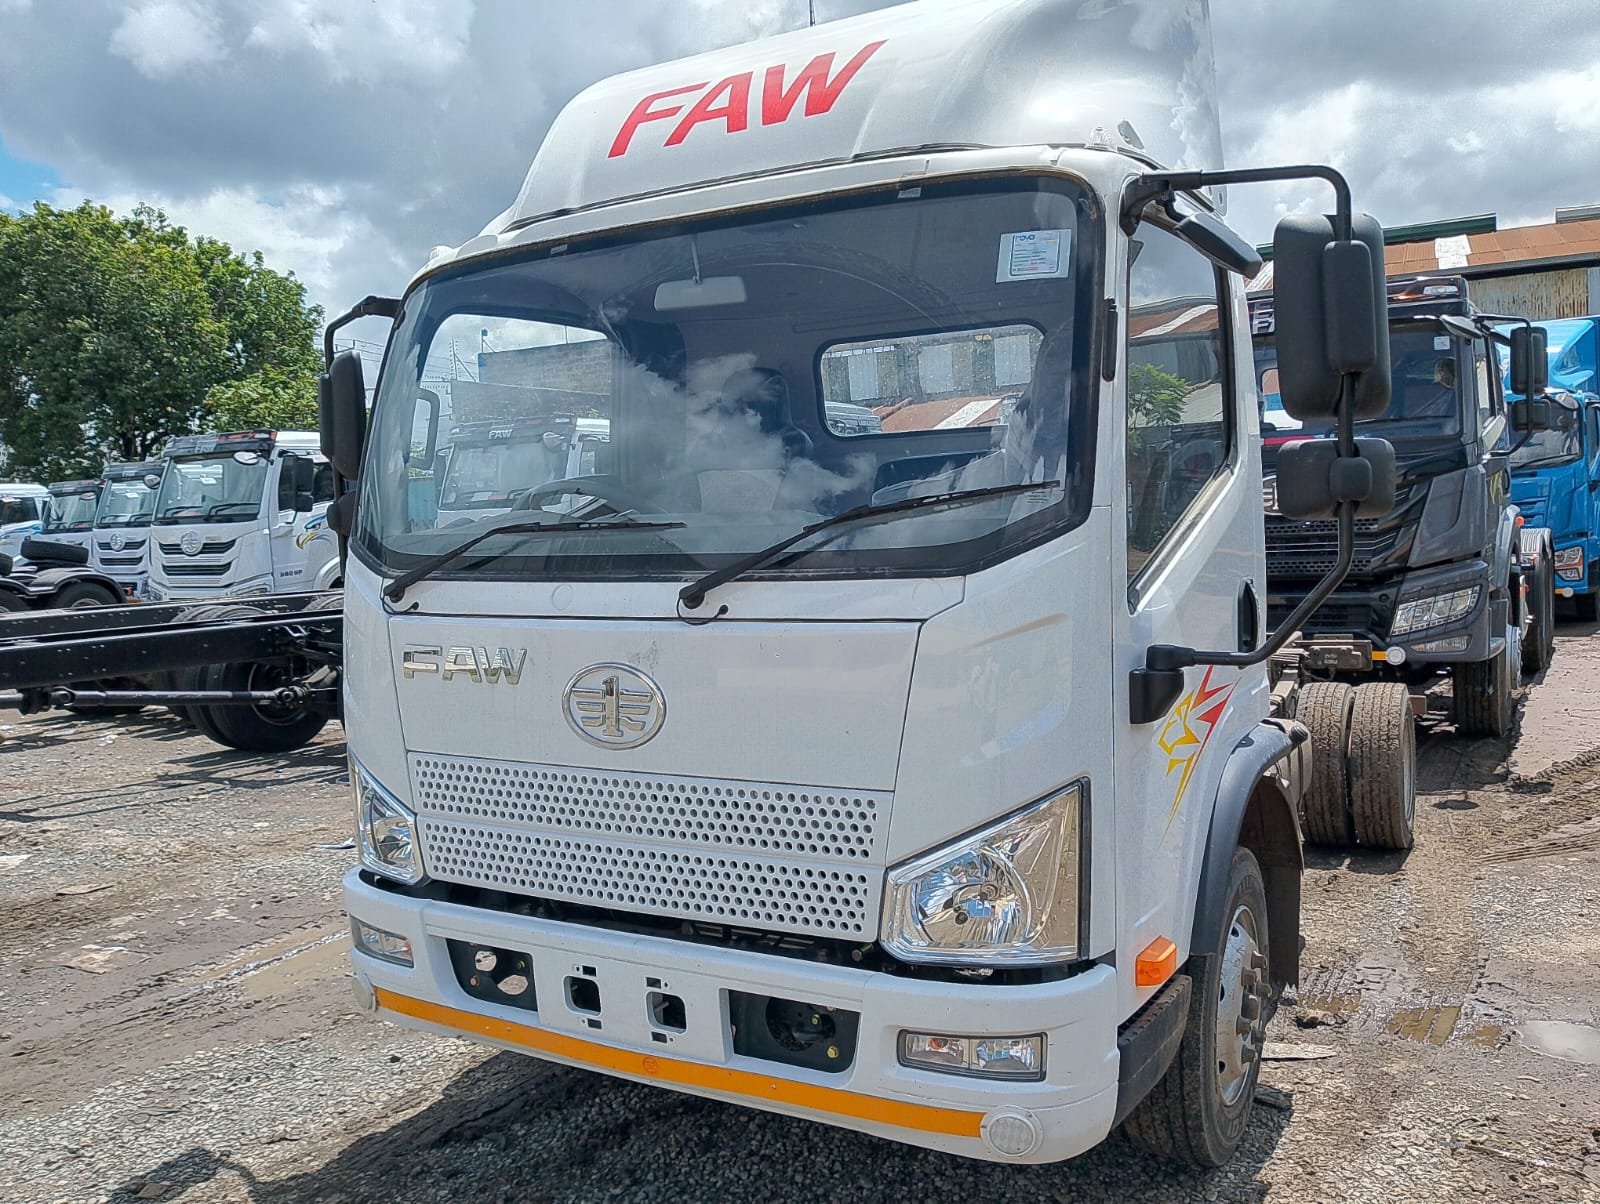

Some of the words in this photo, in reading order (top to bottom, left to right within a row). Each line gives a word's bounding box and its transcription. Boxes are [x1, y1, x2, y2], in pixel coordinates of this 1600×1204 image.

[607, 39, 889, 158] FAW
[488, 429, 513, 440] FAW
[403, 644, 527, 686] FAW
